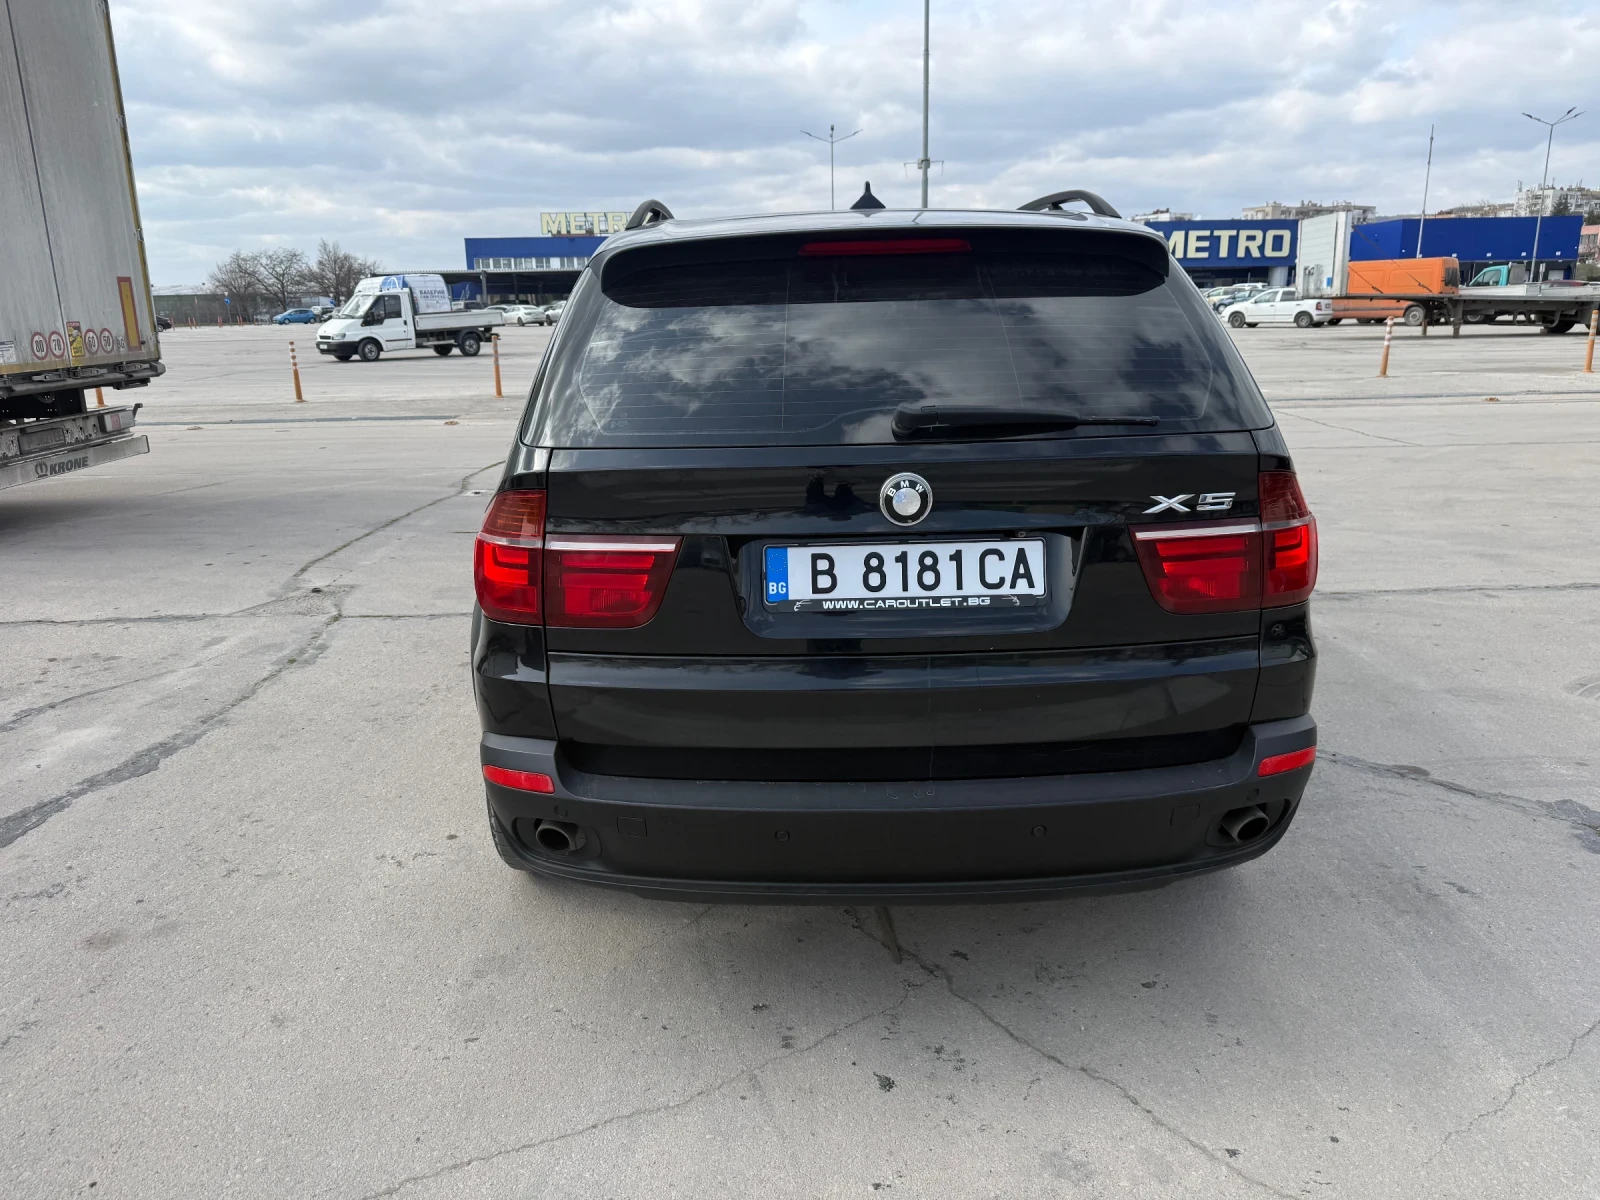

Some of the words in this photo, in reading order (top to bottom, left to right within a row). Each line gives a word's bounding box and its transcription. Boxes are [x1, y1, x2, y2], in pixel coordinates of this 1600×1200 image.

[540, 212, 653, 235] METR
[34, 339, 45, 353] 80
[52, 338, 62, 352] 70
[87, 336, 96, 348] 60
[102, 335, 111, 348] 50
[49, 456, 89, 476] KRONE
[888, 480, 925, 497] BMW
[1142, 492, 1236, 514] X5
[768, 582, 787, 594] BG
[822, 595, 991, 610] WWW.CAROUTLET.BG
